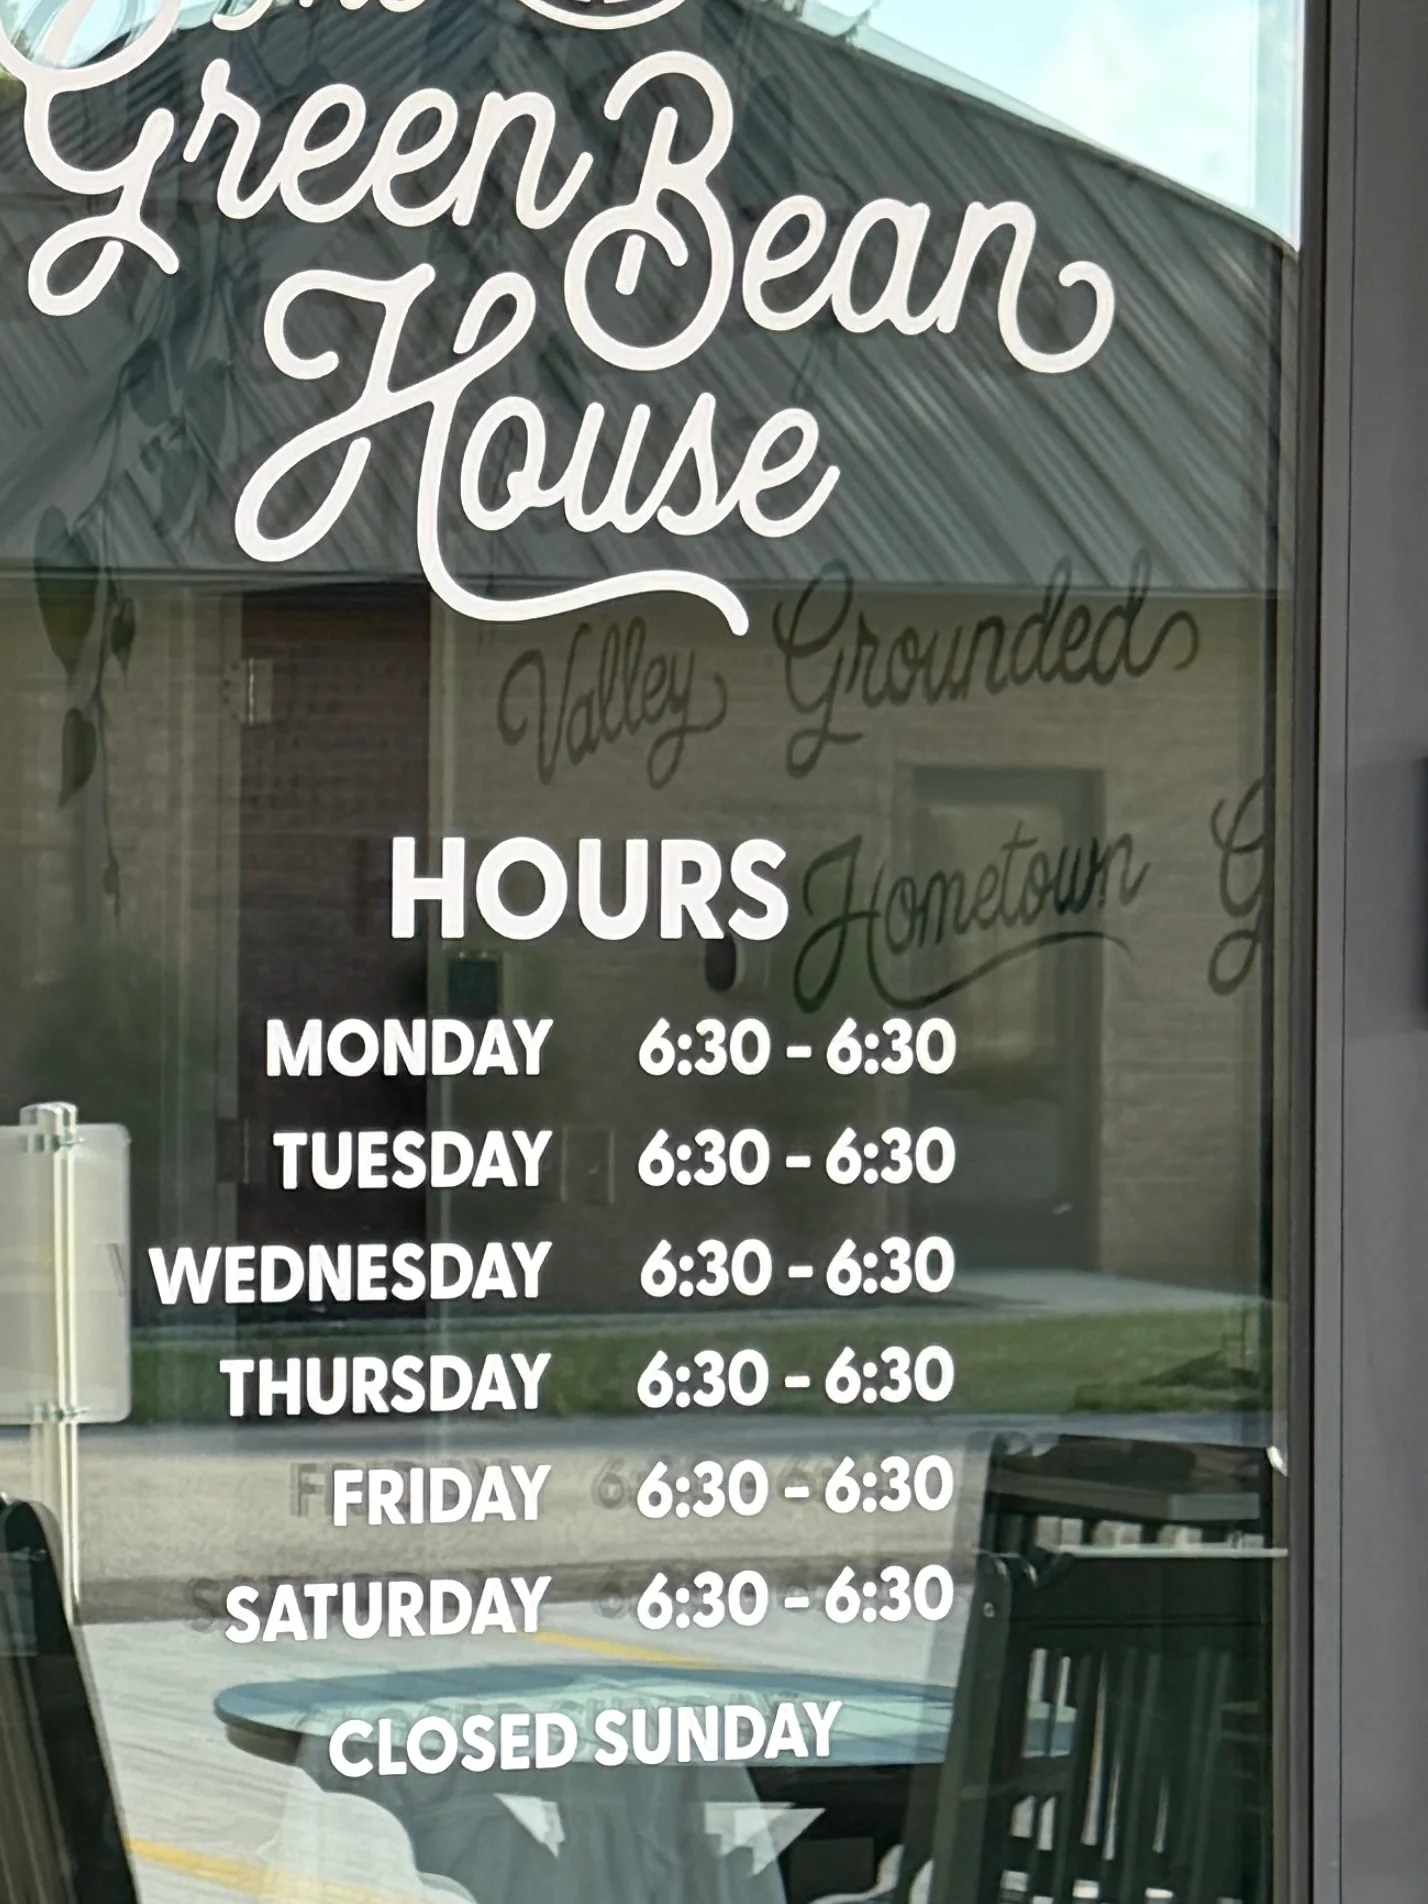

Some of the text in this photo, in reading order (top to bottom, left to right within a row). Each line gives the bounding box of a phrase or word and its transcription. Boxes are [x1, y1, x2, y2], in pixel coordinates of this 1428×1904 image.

[563, 50, 1116, 374] Bean
[234, 261, 840, 636] House
[497, 616, 728, 789] Valley
[774, 549, 1200, 778] Grounded
[391, 836, 790, 941] HOURS
[793, 819, 1150, 1014] Hometown
[266, 1018, 554, 1077] MONDAY
[639, 1018, 772, 1076] 6:30
[825, 1016, 957, 1075] 6:30
[273, 1130, 553, 1191] TUESDAY
[637, 1128, 771, 1187] 6:30
[825, 1126, 957, 1185] 6:30
[148, 1241, 553, 1305] WEDNESDAY
[639, 1238, 773, 1297] 6:30
[825, 1236, 956, 1296] 6:30
[219, 1353, 553, 1417] THURSDAY
[637, 1349, 770, 1408] 6:30
[824, 1345, 955, 1404] 6:30
[332, 1464, 552, 1528] FRIDAY
[636, 1459, 770, 1519] 6:30
[824, 1454, 955, 1514] 6:30
[224, 1574, 552, 1645] SATURDAY
[636, 1570, 770, 1630] 6:30
[824, 1564, 955, 1625] 6:30
[328, 1699, 844, 1779] CLOSED SUNDAY
